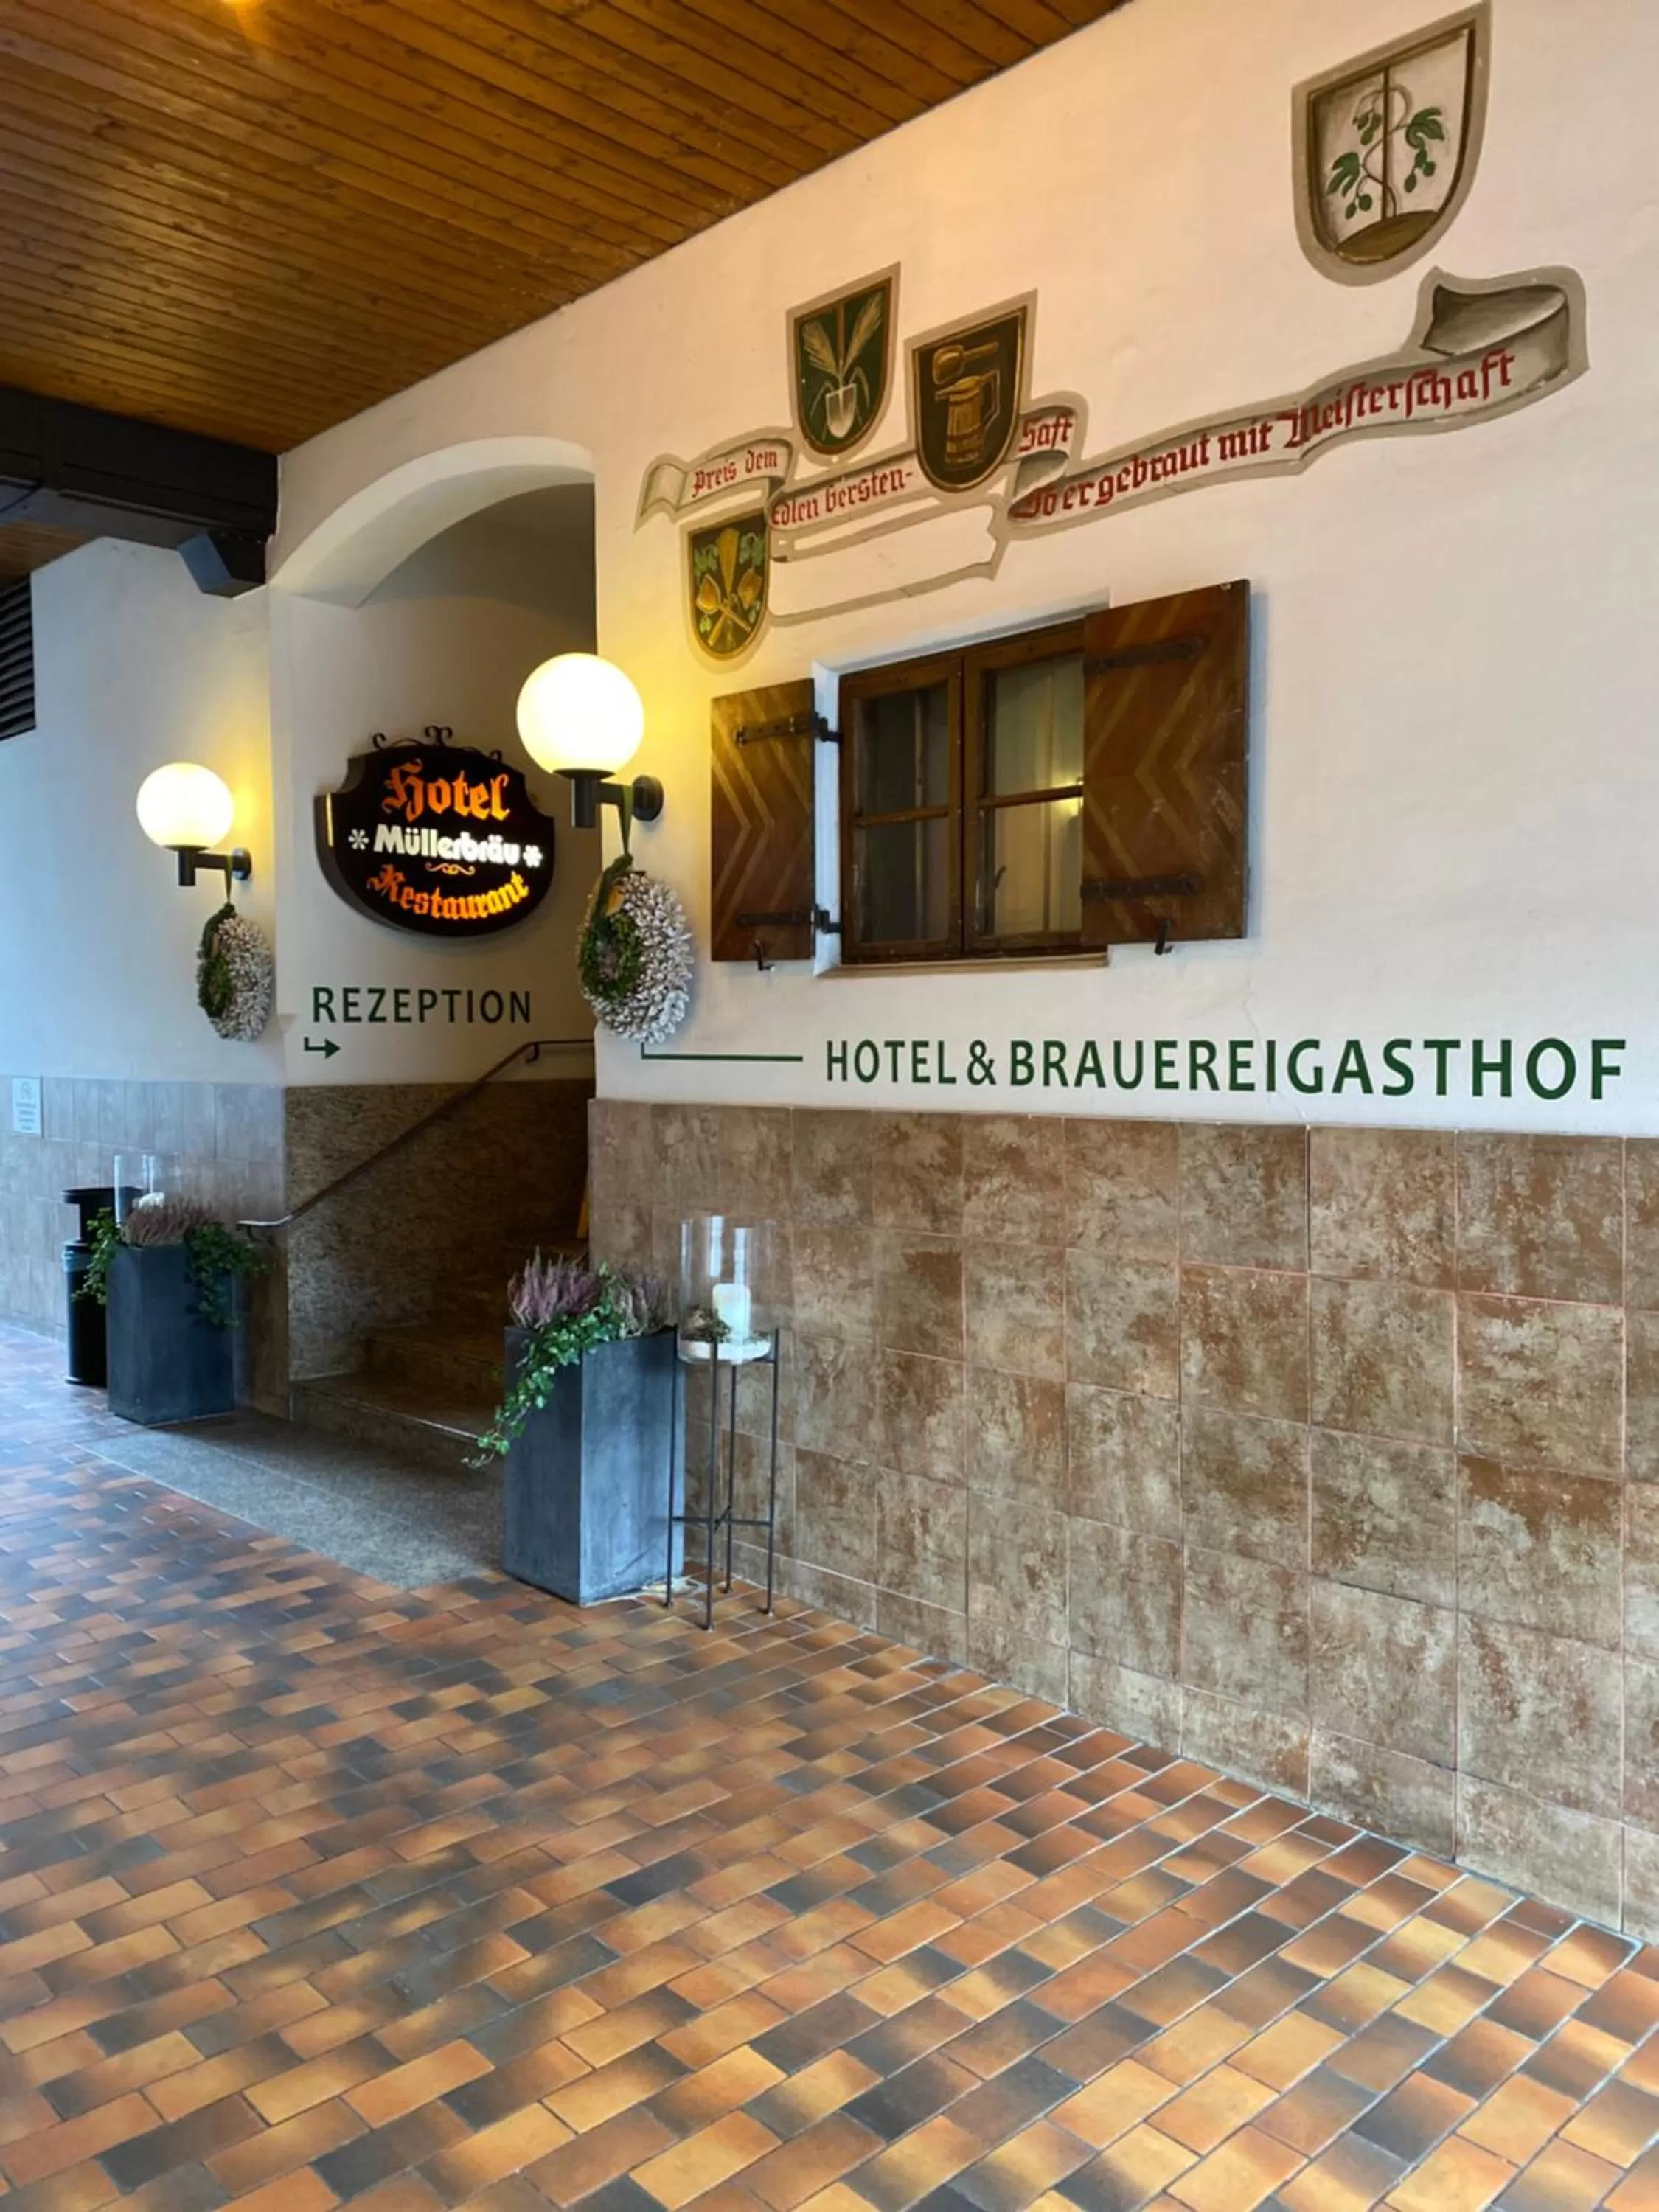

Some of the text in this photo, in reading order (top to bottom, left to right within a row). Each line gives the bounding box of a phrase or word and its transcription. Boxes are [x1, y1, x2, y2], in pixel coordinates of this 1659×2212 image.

[1217, 420, 1273, 460] mit
[381, 758, 510, 822] Hotel
[374, 824, 520, 865] Müllerbräu
[367, 864, 529, 920] Restaurant
[313, 987, 532, 1023] REZEPTION
